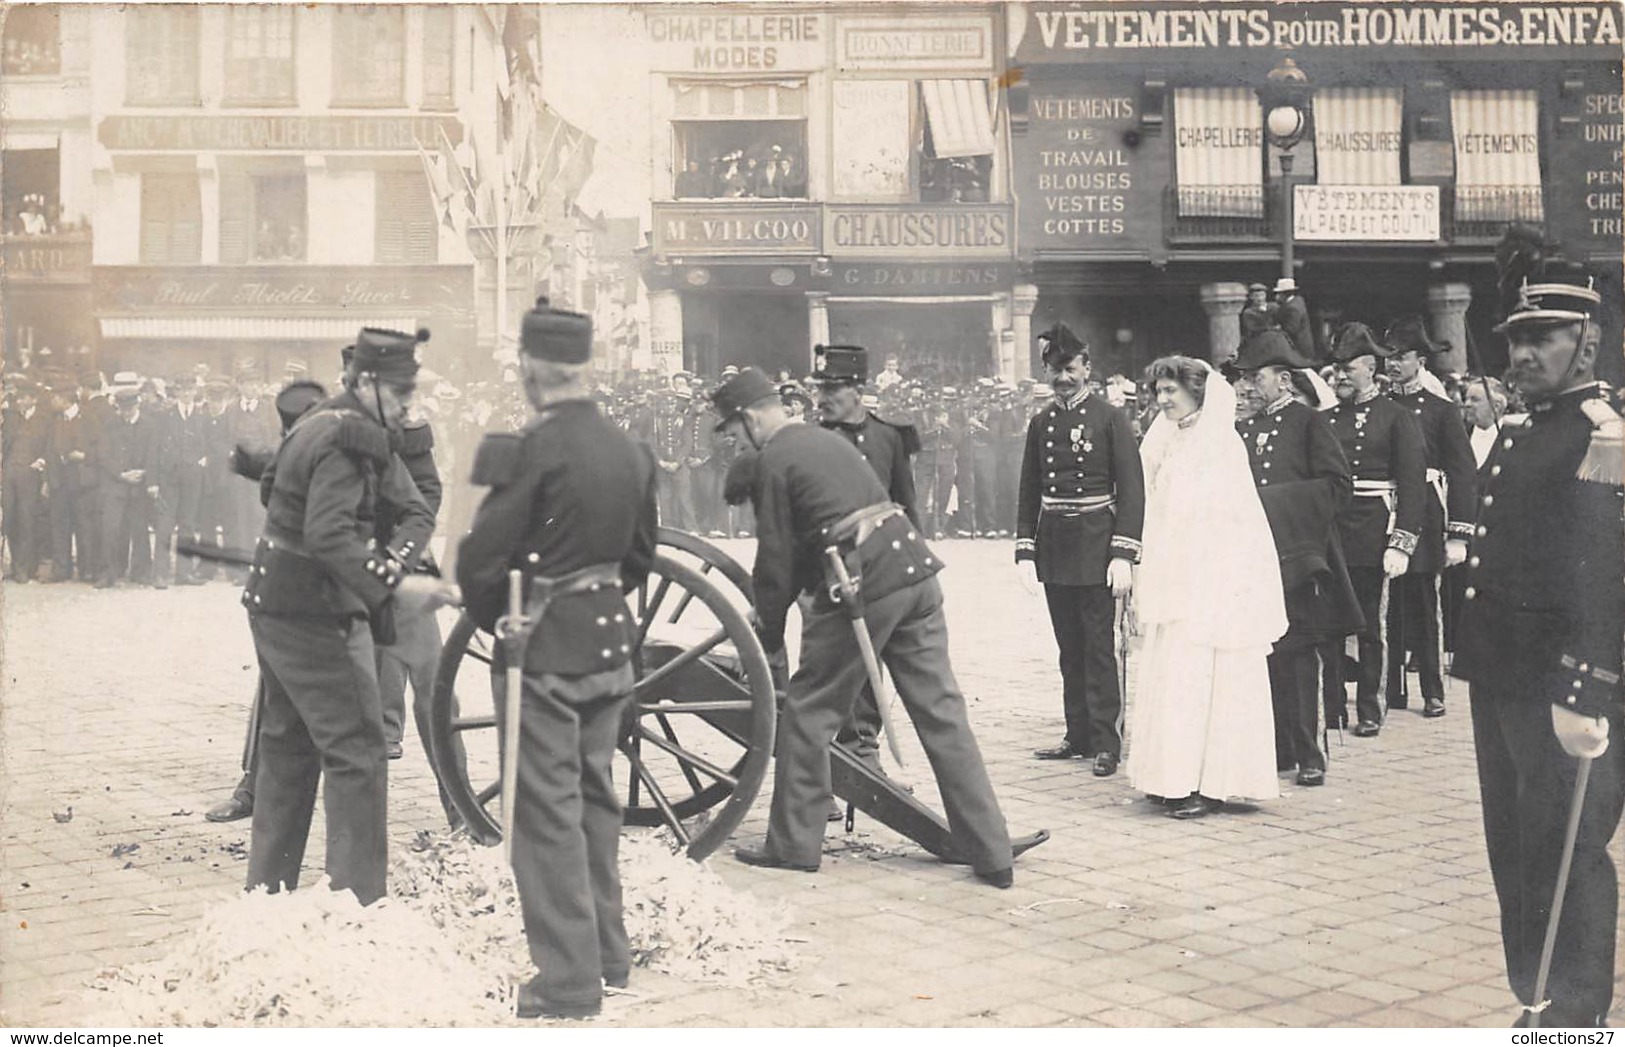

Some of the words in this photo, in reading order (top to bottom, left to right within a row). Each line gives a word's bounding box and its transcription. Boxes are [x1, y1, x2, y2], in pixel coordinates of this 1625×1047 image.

[650, 15, 818, 42] CHAPELLERIE
[1036, 3, 1271, 48] VÊTEMENTS
[1273, 21, 1340, 46] POUR
[1341, 7, 1500, 45] HOMMES
[852, 34, 975, 54] BONNETERIE
[693, 46, 777, 68] MODES
[216, 117, 310, 147] CHEVALIER
[319, 121, 343, 147] ET
[1067, 129, 1093, 140] DE
[1179, 126, 1262, 148] CHAPELLERIE
[1317, 131, 1401, 152] CHAUSSURES
[1040, 150, 1128, 166] TRAVAIL
[1039, 172, 1131, 189] BLOUSES
[1046, 195, 1124, 211] VESTES
[833, 211, 1006, 248] CHAUSSURES
[1044, 219, 1124, 235] COTTES
[1297, 213, 1357, 234] ALPAGA
[1381, 213, 1436, 234] COUTIL
[874, 267, 998, 285] DAMIENS
